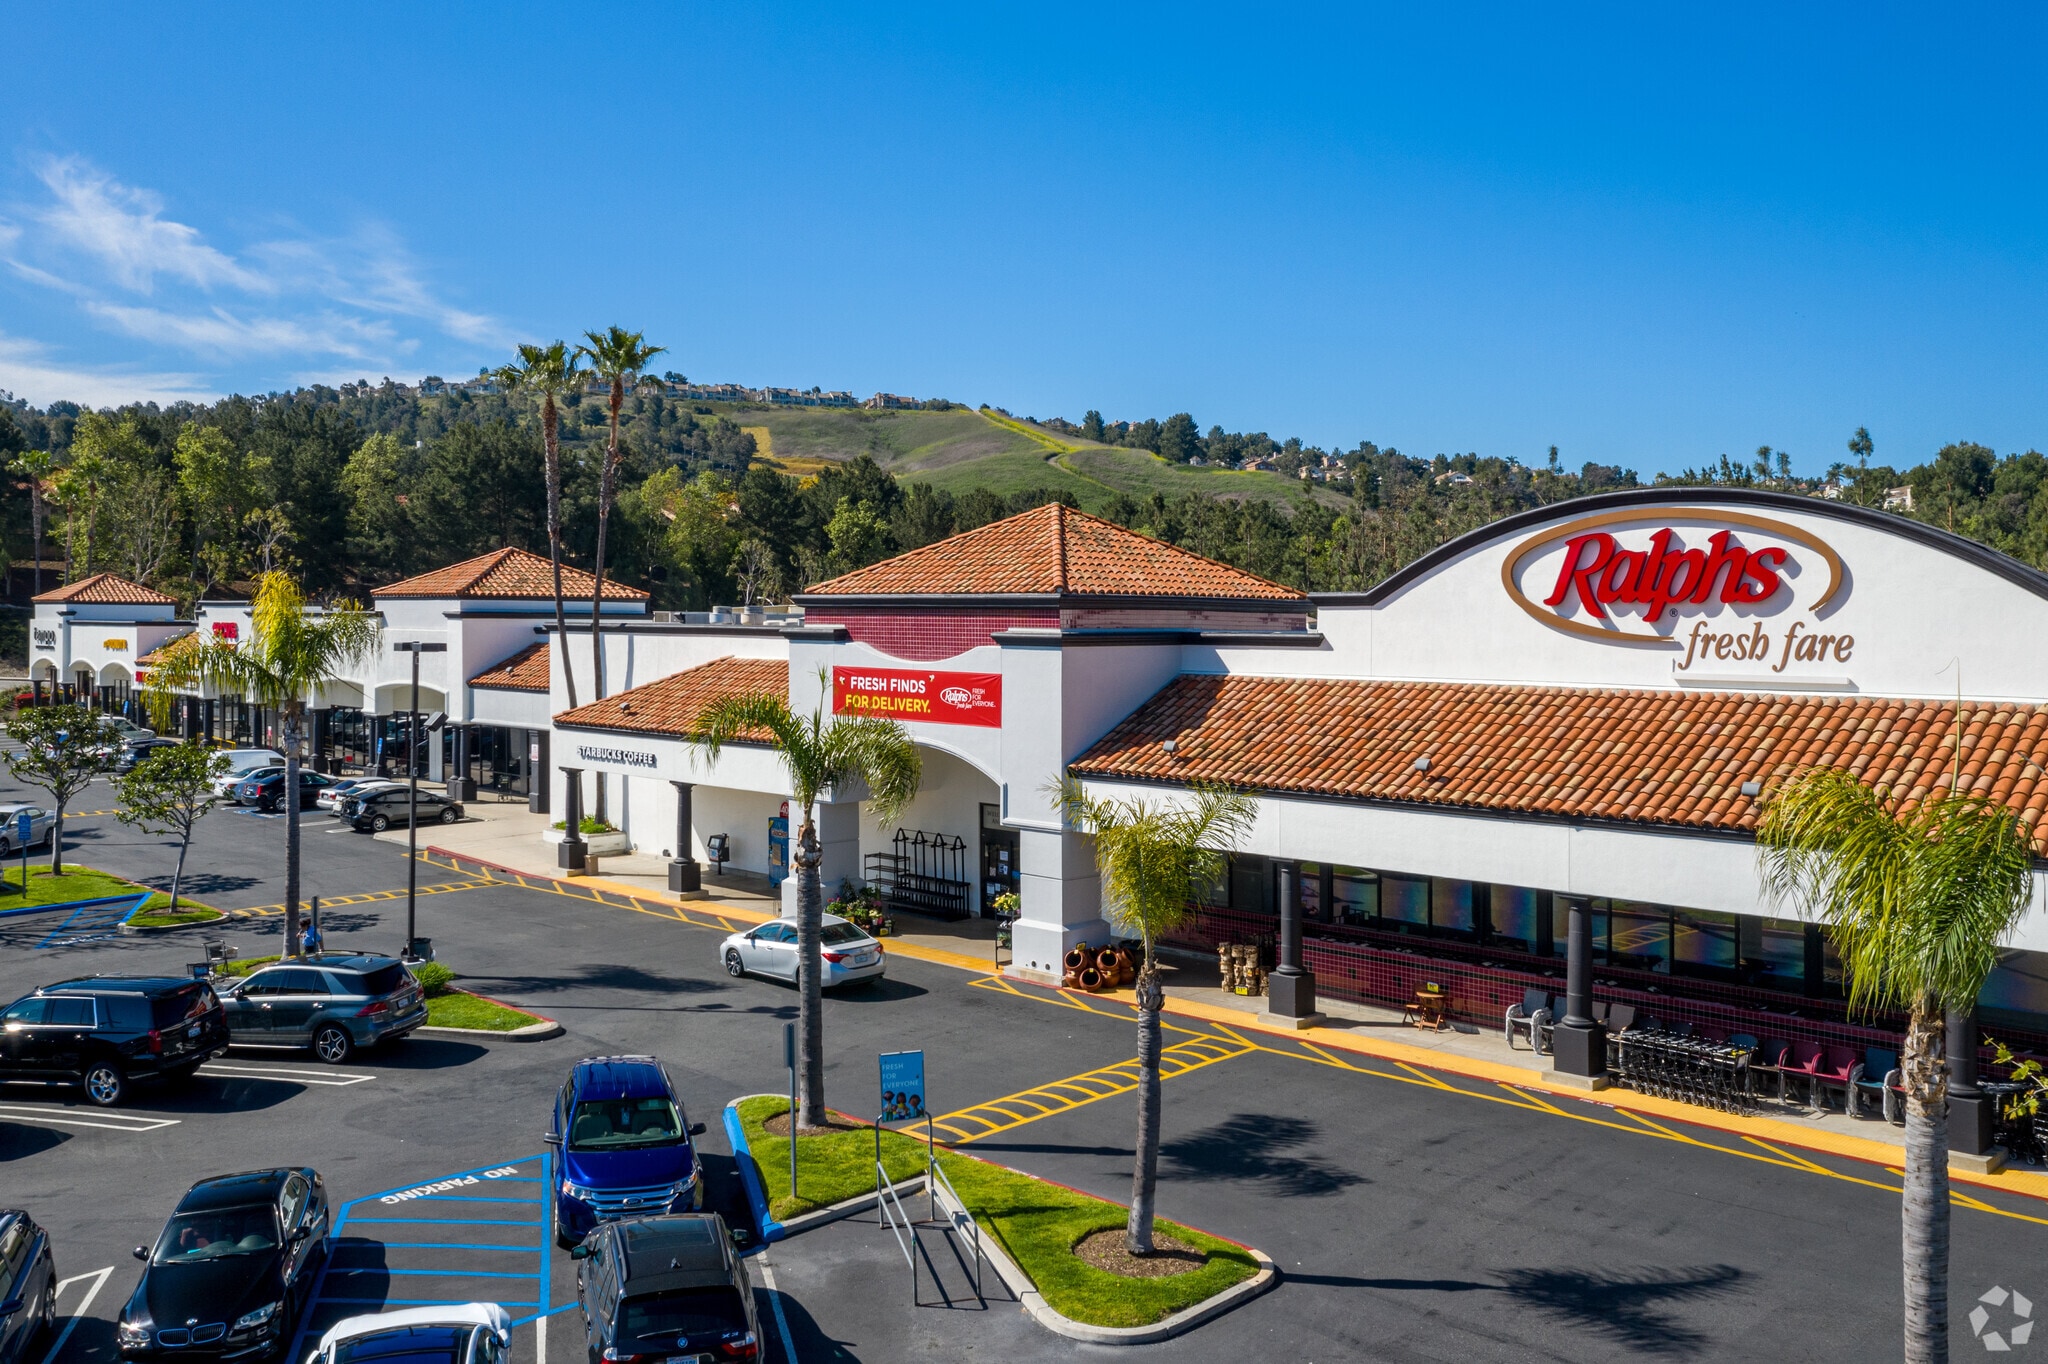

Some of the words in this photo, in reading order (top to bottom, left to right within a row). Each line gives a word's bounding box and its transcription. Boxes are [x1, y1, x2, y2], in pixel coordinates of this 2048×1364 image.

[1543, 527, 1788, 622] Ralphs
[1677, 620, 1769, 671] fresh
[1772, 621, 1855, 672] fare
[850, 676, 887, 691] FRESH
[890, 678, 926, 694] FINDS
[845, 694, 869, 708] FOR
[872, 695, 931, 713] DELIVERY.
[945, 689, 968, 703] Ralphs
[577, 745, 622, 760] STARBUCKS
[623, 751, 653, 764] COFFEE
[483, 1166, 519, 1179] NO
[379, 1175, 480, 1205] PARKING
